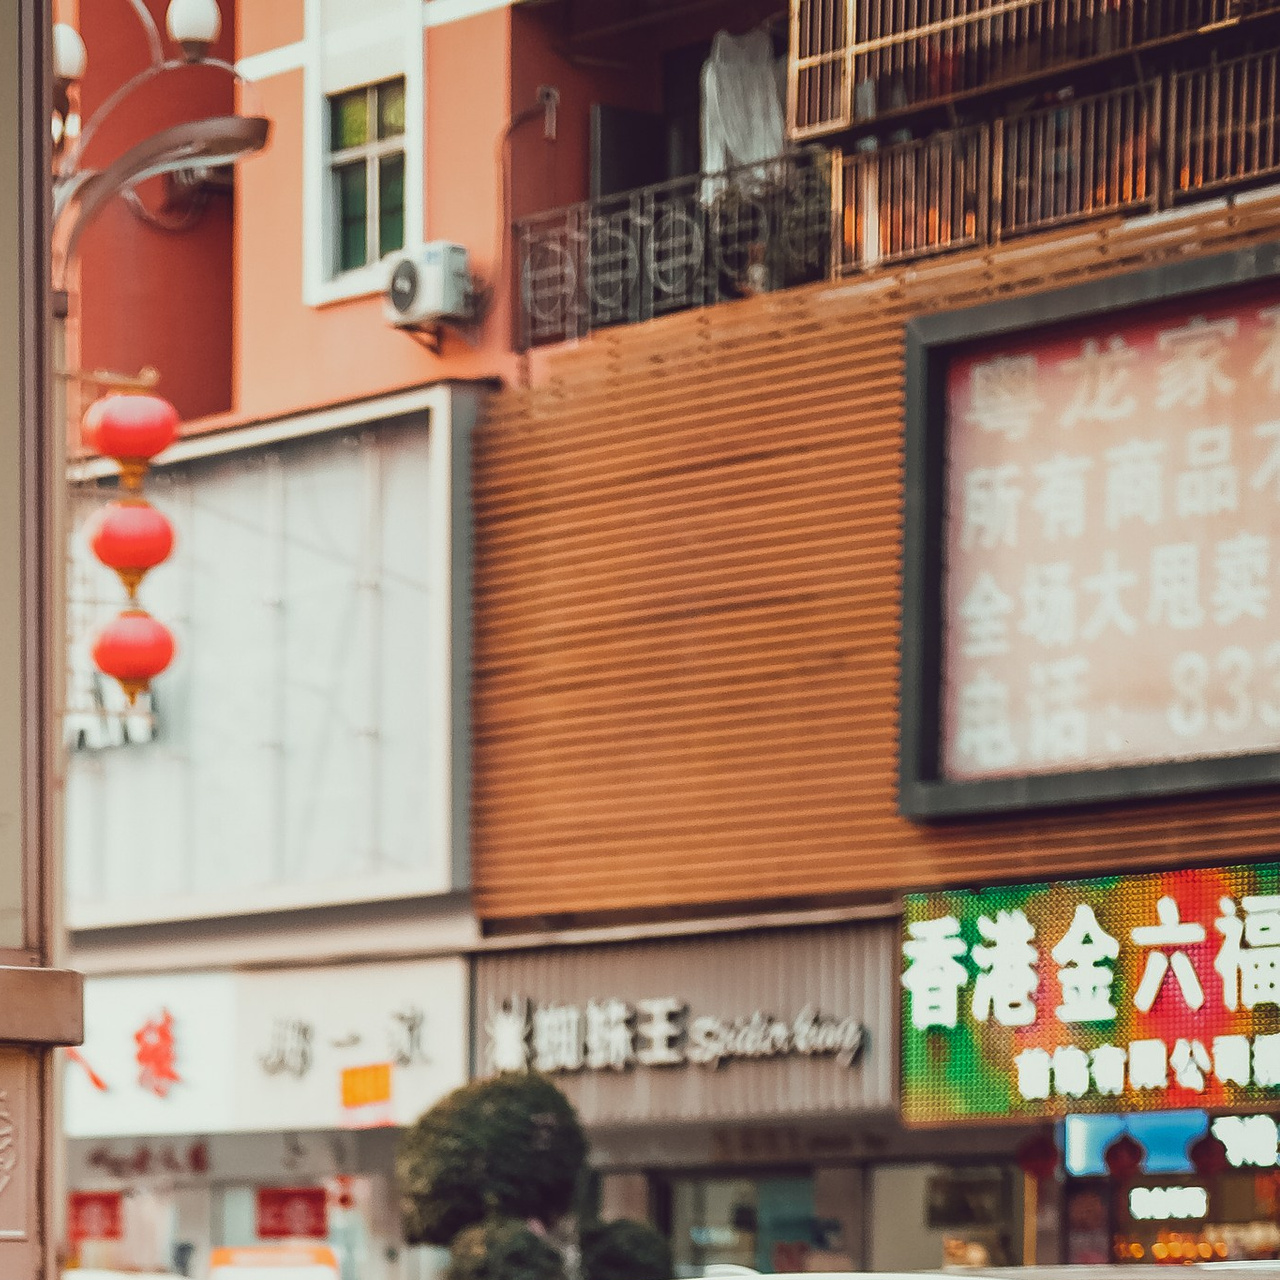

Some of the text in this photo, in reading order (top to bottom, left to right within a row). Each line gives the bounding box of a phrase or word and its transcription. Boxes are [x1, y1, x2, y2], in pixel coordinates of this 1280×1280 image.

[901, 895, 1280, 1030] 香港金六福
